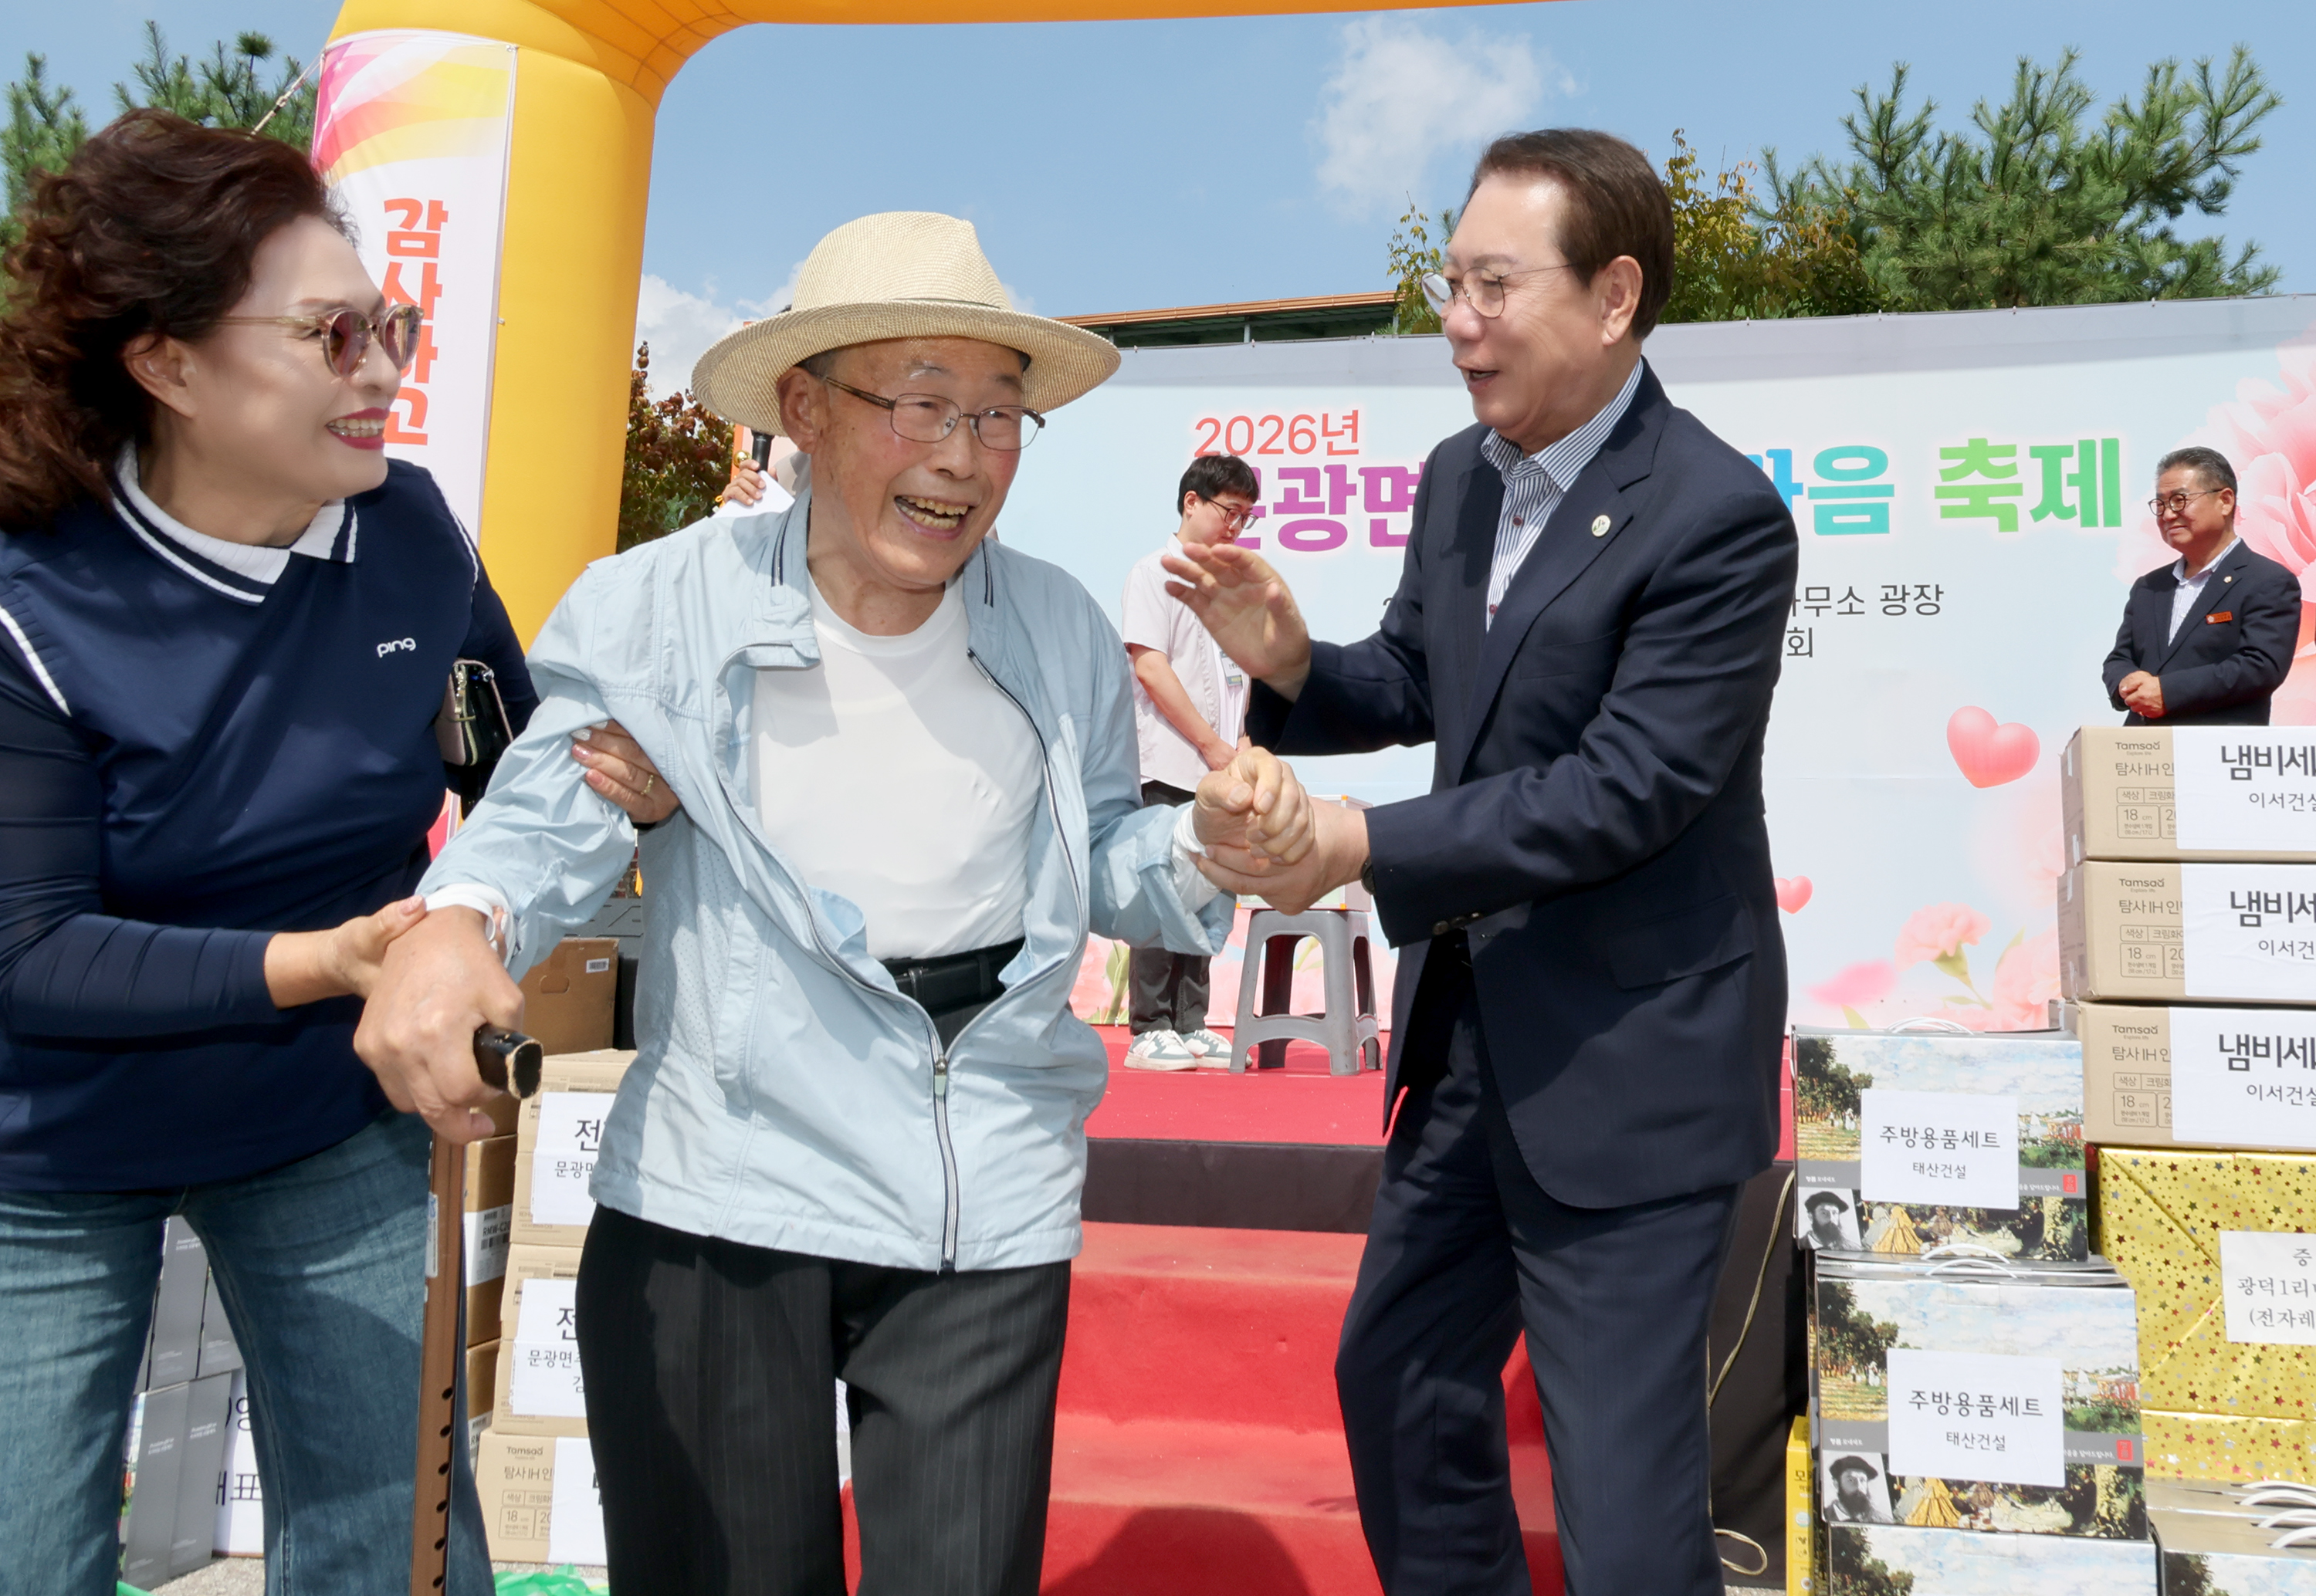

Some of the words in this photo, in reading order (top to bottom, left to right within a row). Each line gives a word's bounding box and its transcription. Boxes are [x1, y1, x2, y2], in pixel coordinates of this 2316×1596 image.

[1194, 410, 1359, 458] 2026년
[1234, 462, 1425, 552] 광면
[1935, 438, 2121, 533] 축제
[1790, 585, 1865, 617] 무소
[1879, 583, 1944, 616] 광장
[377, 637, 416, 658] ping
[2115, 762, 2142, 776] 탐사
[2221, 745, 2316, 780] 냄비세
[2122, 790, 2140, 800] 색상
[2124, 808, 2138, 821] 18
[2165, 809, 2176, 821] 2
[2119, 899, 2147, 914] 탐사
[2166, 901, 2182, 915] 인
[2126, 928, 2143, 938] 색상
[2128, 947, 2142, 959] 18
[2112, 1047, 2139, 1061] 탐사
[2219, 1034, 2316, 1071] 냄비세
[2119, 1077, 2137, 1087] 색상
[2121, 1095, 2135, 1107] 18
[574, 1119, 606, 1152] 전
[1880, 1125, 2000, 1150] 주방용품세트
[1912, 1161, 1966, 1179] 태산건설
[2293, 1248, 2312, 1266] 증
[2237, 1276, 2316, 1298] 광덕1리
[2250, 1307, 2316, 1329] (전자레
[1908, 1390, 2043, 1418] 주방용품세트
[1946, 1431, 2006, 1452] 태산건설
[506, 1510, 518, 1522] 18
